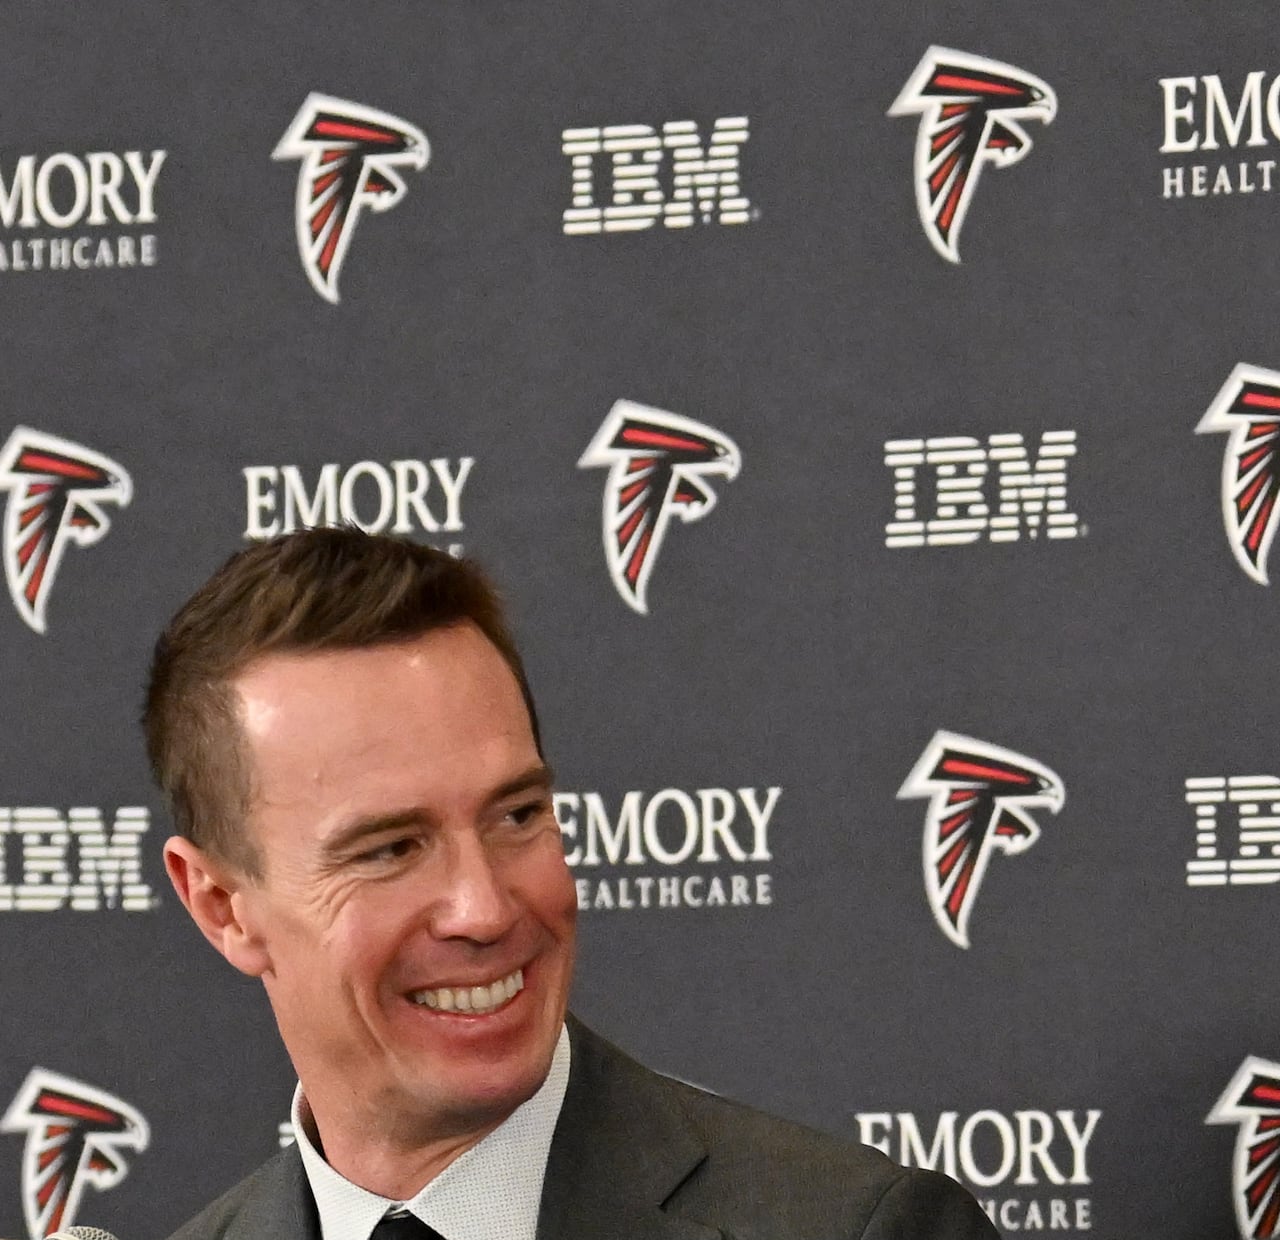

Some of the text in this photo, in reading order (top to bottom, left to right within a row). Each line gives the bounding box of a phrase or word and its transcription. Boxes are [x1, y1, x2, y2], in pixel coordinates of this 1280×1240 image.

[561, 116, 750, 235] IBM
[241, 456, 476, 540] EMORY
[884, 430, 1078, 548] IBM
[552, 786, 783, 867] EMORY
[575, 873, 773, 910] EALTHCARE
